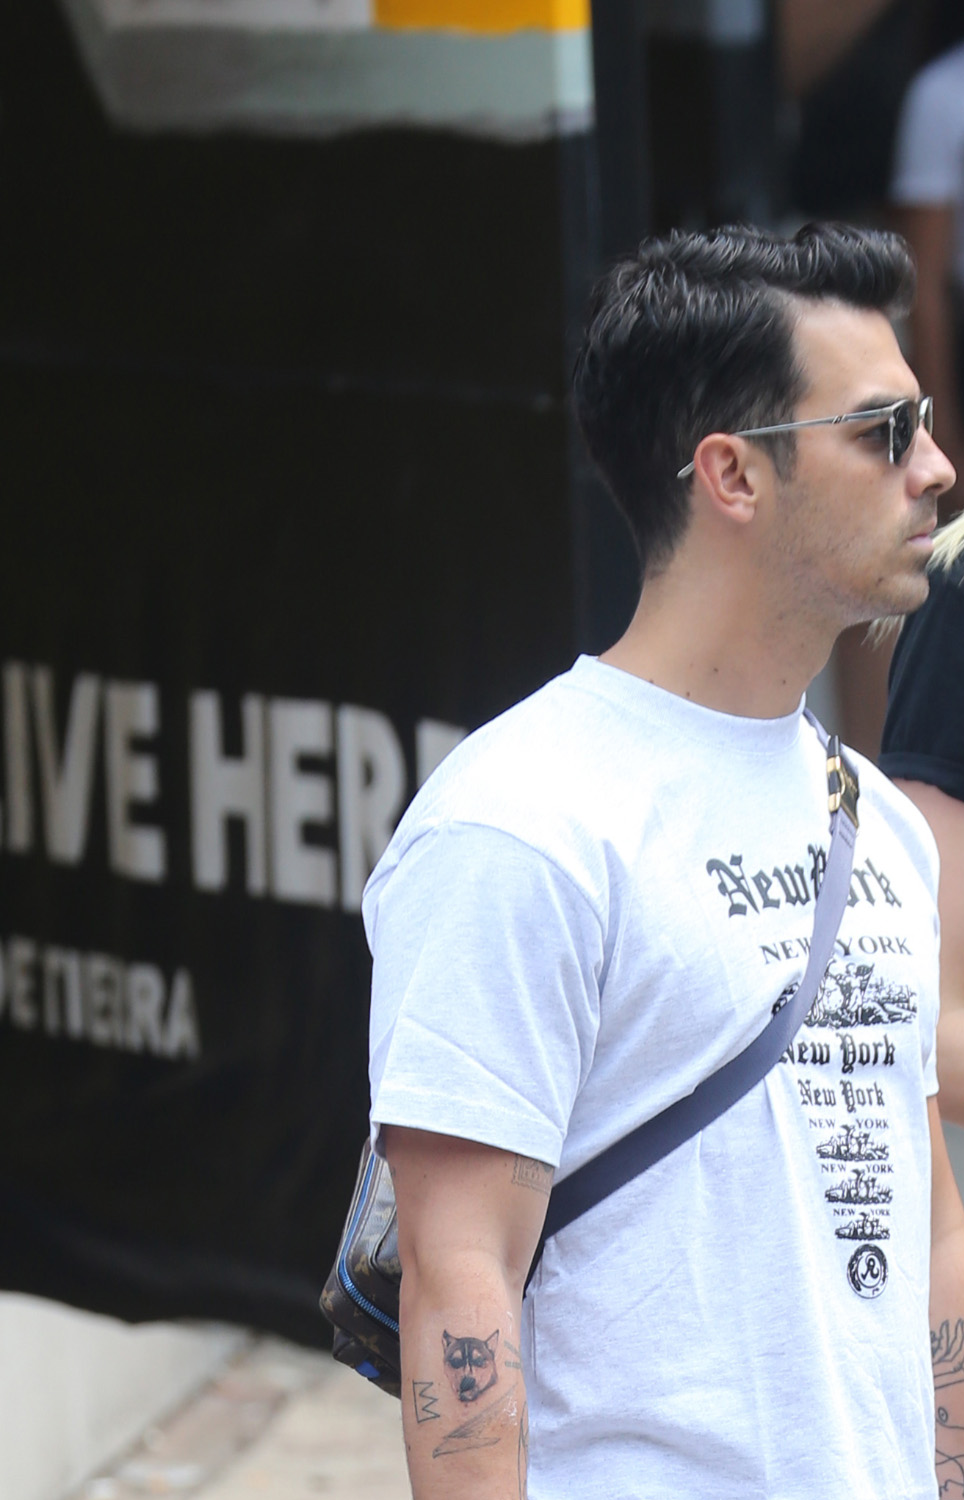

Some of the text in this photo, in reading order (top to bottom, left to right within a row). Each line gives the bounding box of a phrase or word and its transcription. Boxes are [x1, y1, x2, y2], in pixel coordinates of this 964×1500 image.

[706, 853, 812, 918] New
[836, 936, 912, 957] YORK
[836, 1033, 896, 1074] York
[797, 1078, 885, 1113] New York
[808, 1118, 890, 1129] NEW YORK
[821, 1163, 895, 1174] NEW YORK
[833, 1208, 891, 1217] NEW YORK
